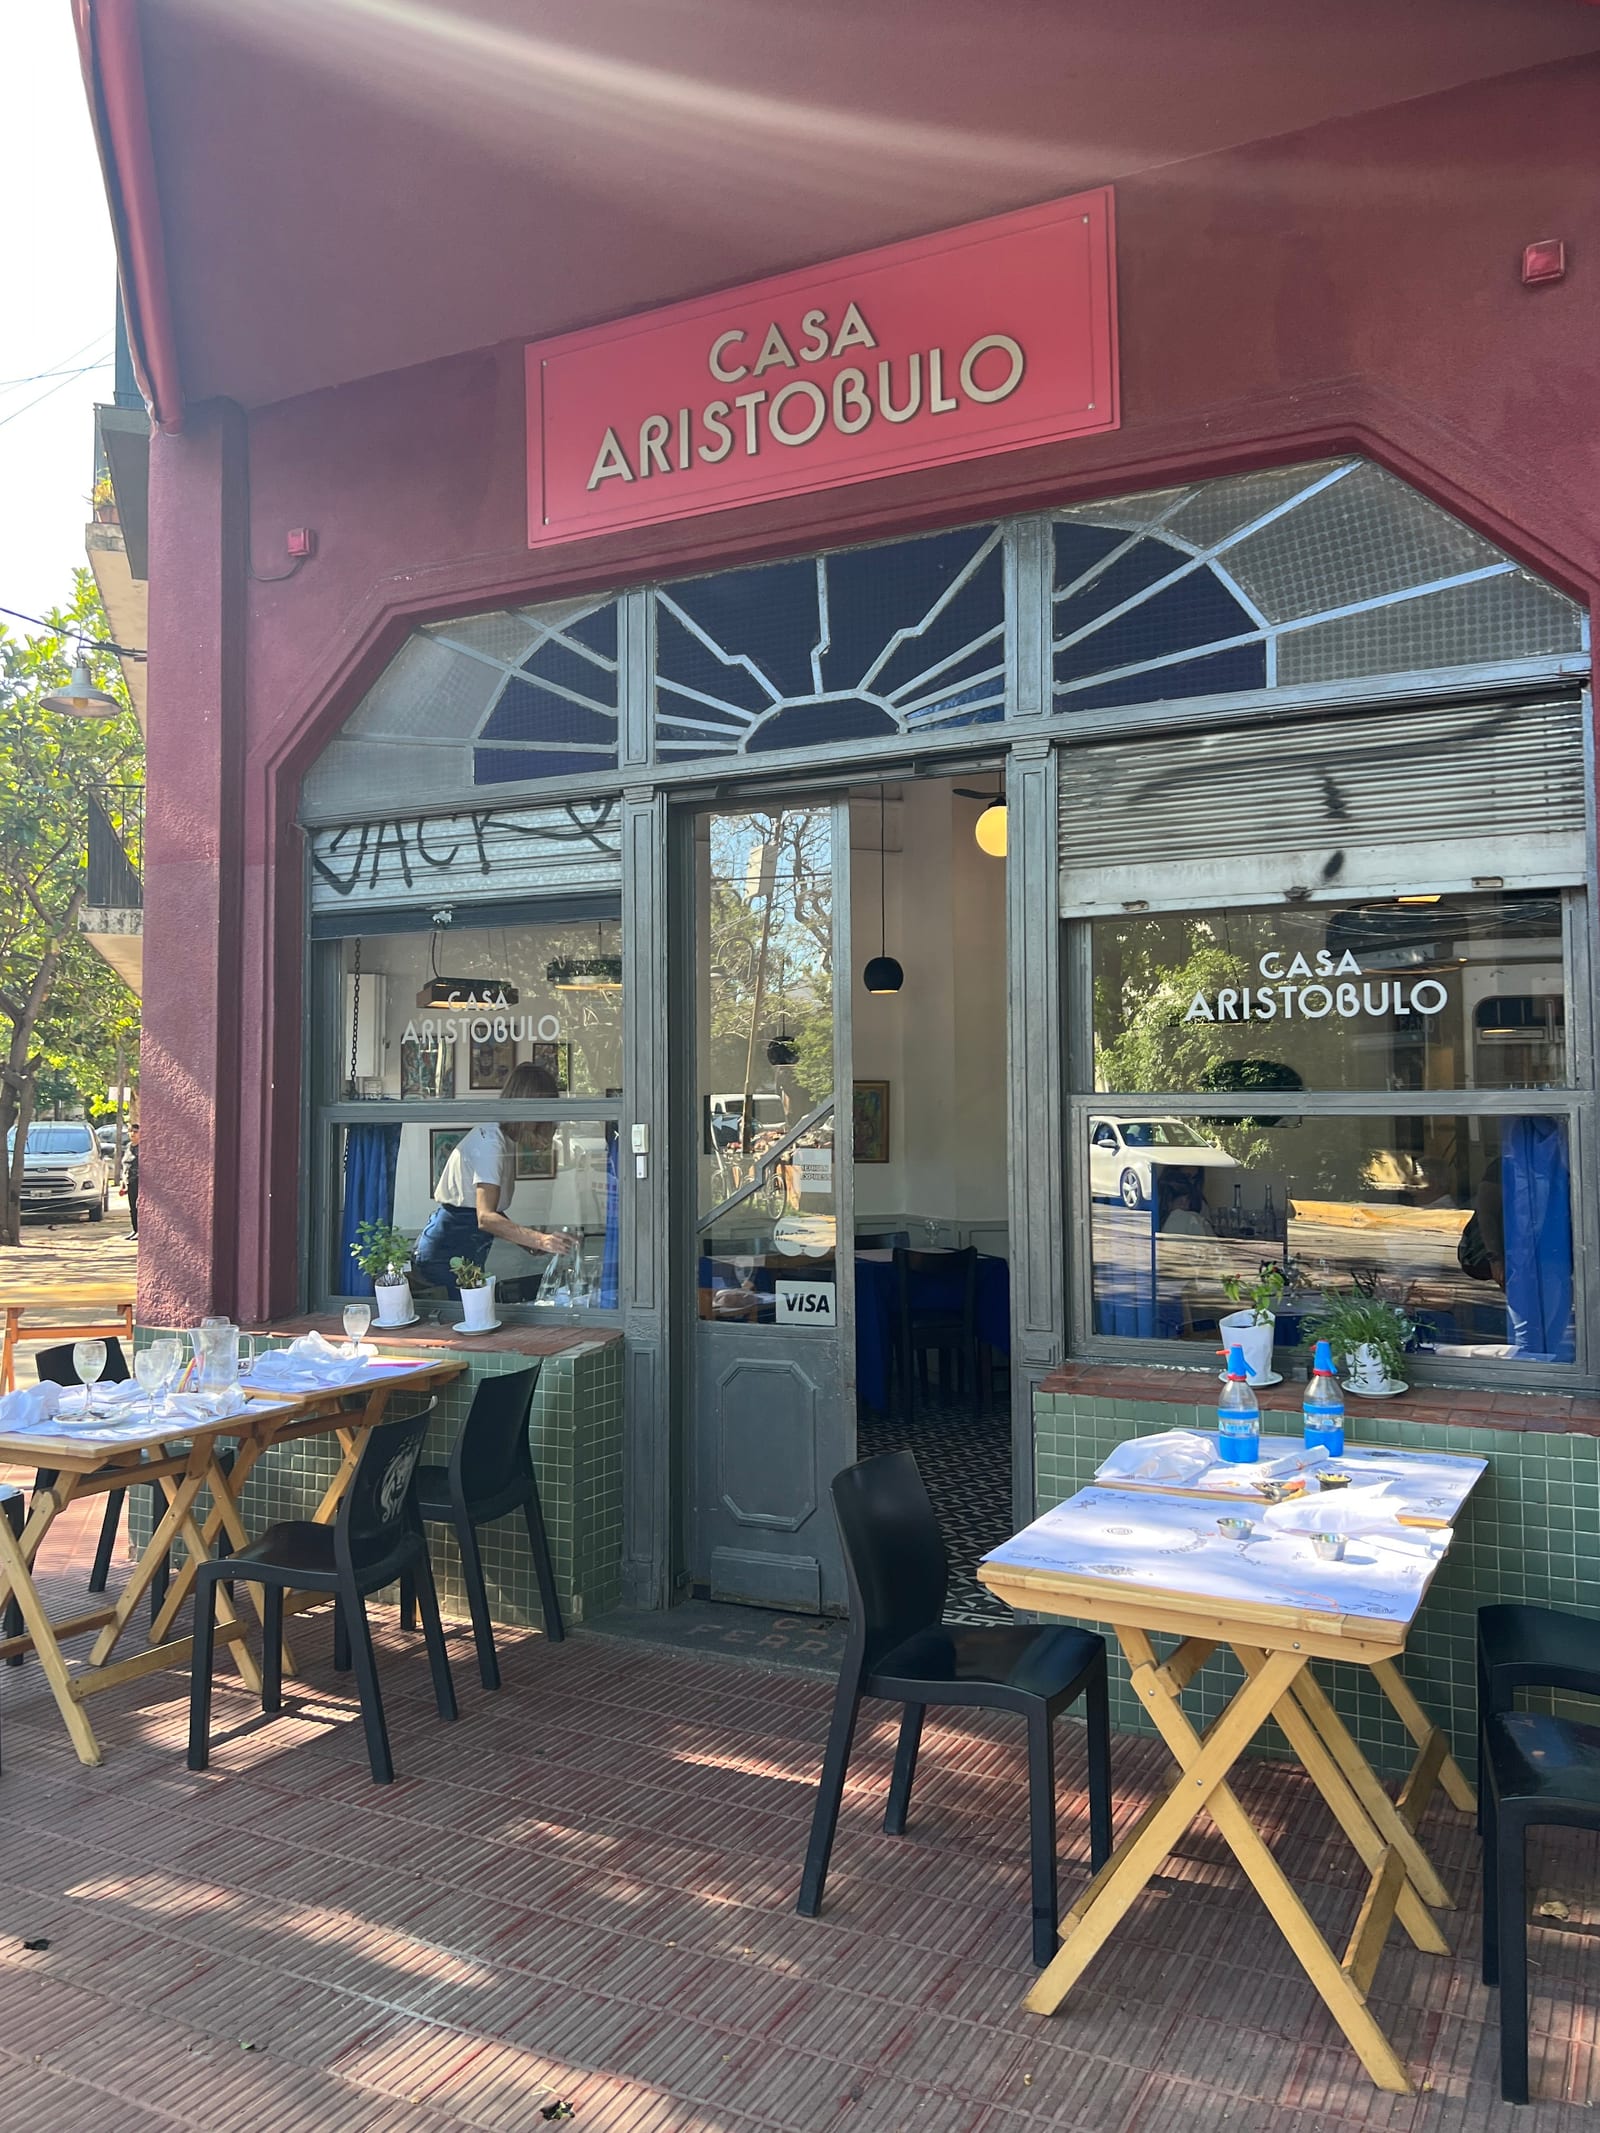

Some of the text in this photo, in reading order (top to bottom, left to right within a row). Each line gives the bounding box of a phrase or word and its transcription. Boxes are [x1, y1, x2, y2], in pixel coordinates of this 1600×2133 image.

[708, 301, 877, 384] CASA
[585, 334, 1025, 490] ARISTOBULO
[1259, 949, 1362, 980] CASA
[447, 989, 510, 1013] CASA
[1185, 979, 1448, 1023] ARISTOBULO
[401, 1015, 561, 1044] ARISTOBULO
[782, 1293, 830, 1313] VISA
